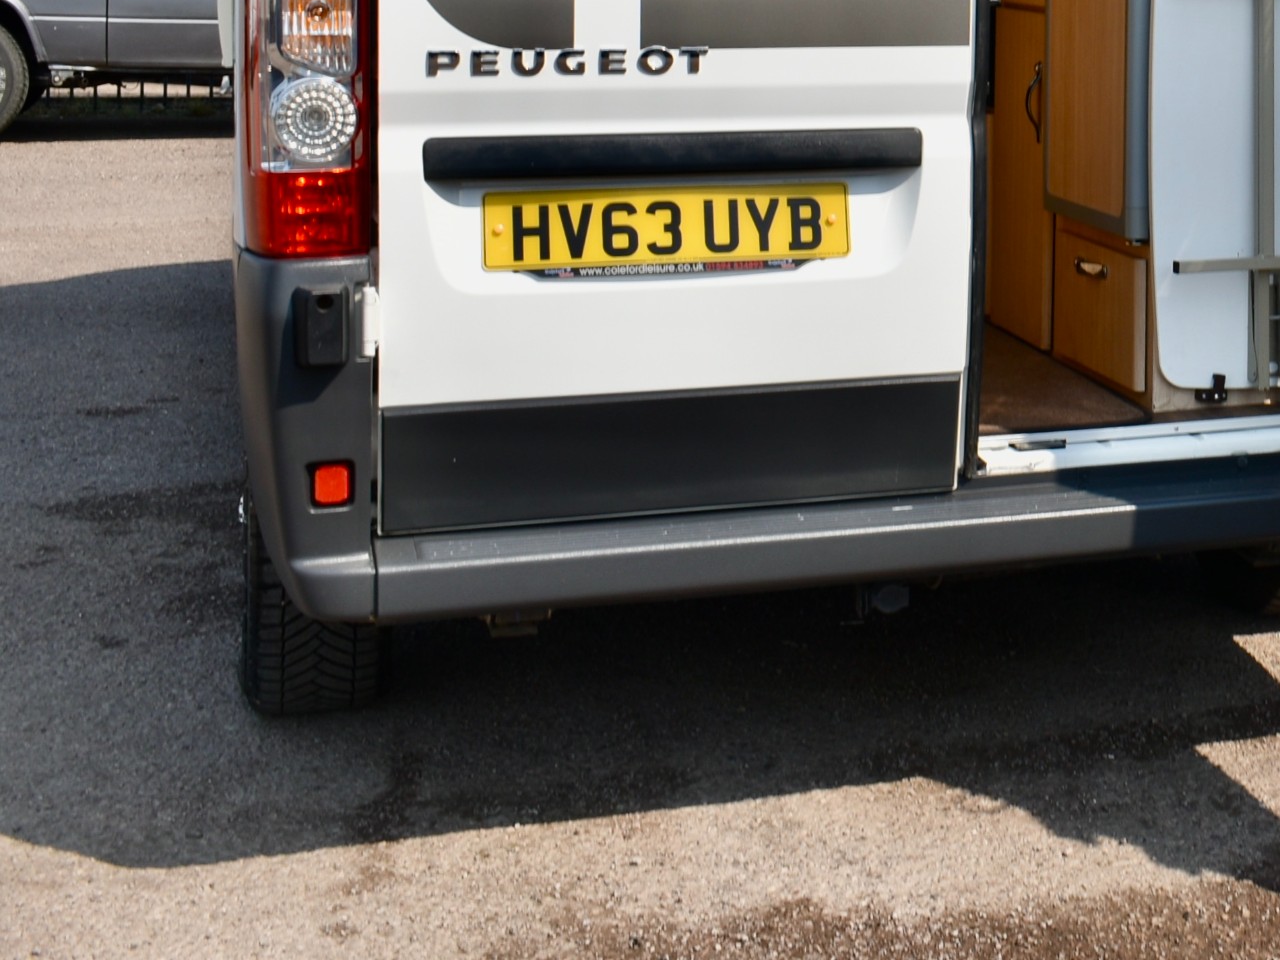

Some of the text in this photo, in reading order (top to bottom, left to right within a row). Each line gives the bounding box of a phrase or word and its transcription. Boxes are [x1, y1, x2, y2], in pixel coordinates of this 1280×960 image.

[425, 45, 710, 78] PEUGEOT
[511, 196, 823, 262] HV63 UYB
[579, 260, 705, 277] www.colefordleisure.co.uk
